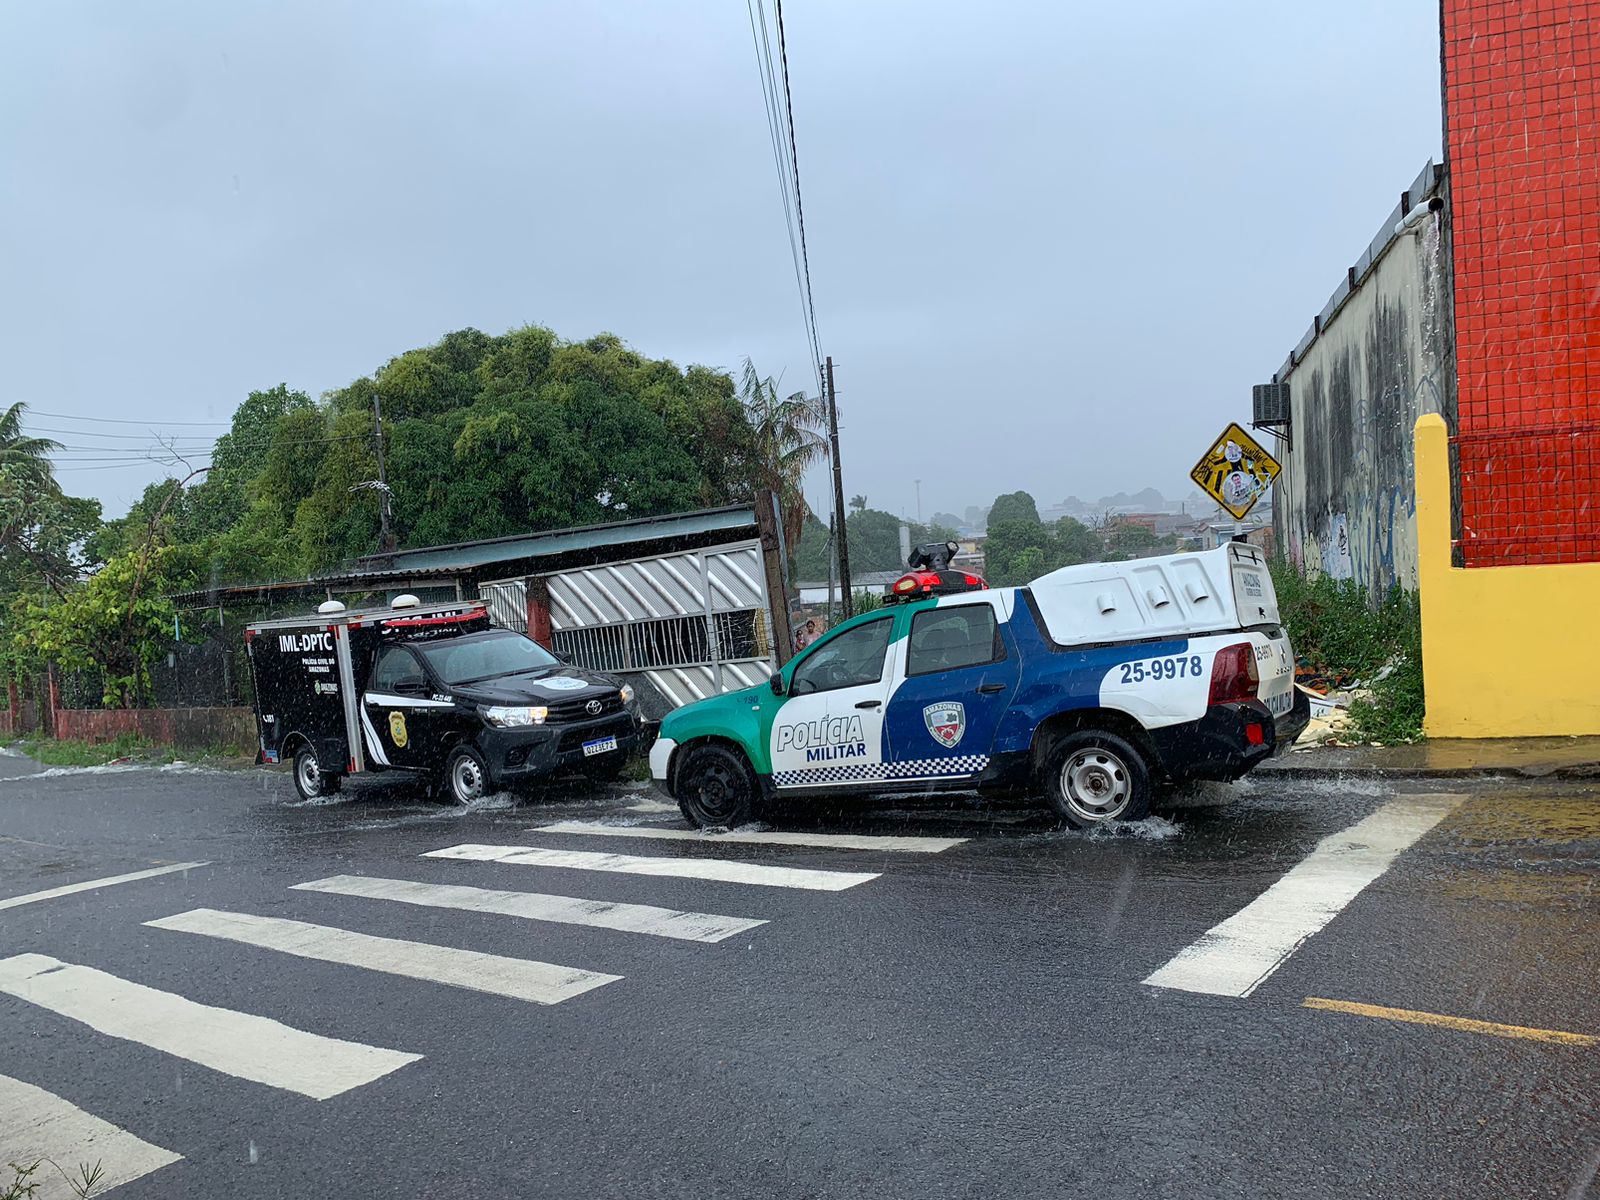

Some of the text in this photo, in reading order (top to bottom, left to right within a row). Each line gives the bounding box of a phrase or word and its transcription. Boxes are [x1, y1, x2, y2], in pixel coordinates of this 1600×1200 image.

[279, 632, 333, 652] IML-DPTC
[1120, 655, 1203, 684] 25-9978
[743, 695, 759, 704] 190
[925, 703, 962, 716] AMAZONAS
[777, 714, 865, 753] POLÍCIA
[806, 743, 867, 762] MILITAR
